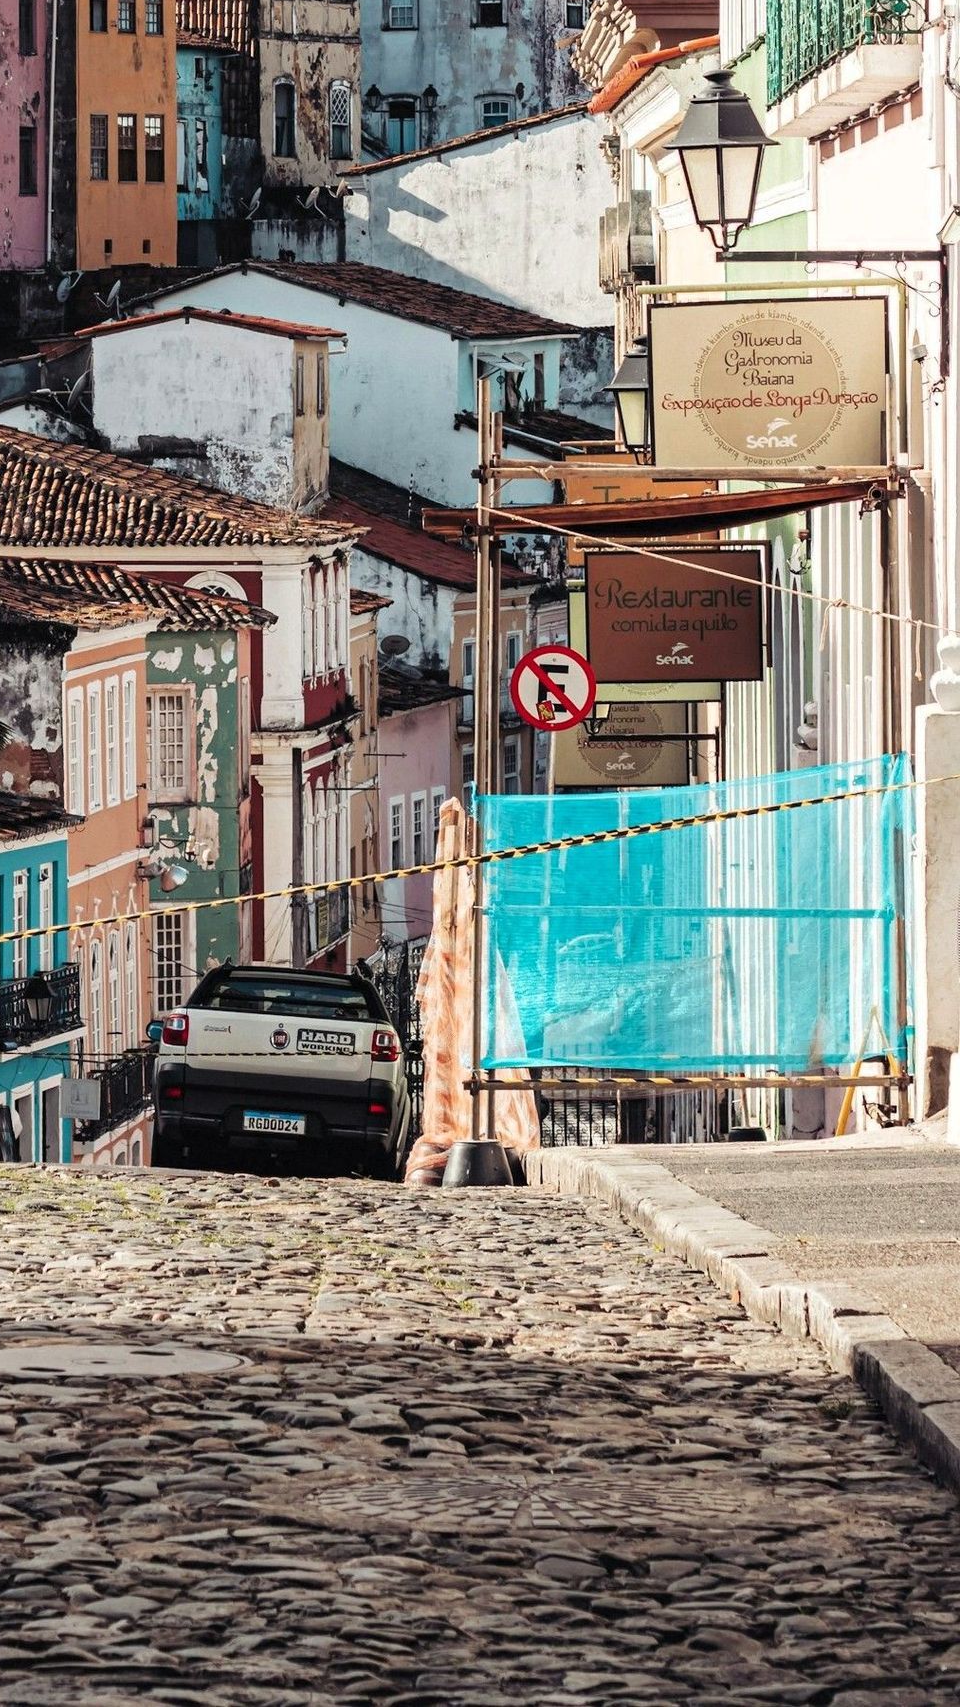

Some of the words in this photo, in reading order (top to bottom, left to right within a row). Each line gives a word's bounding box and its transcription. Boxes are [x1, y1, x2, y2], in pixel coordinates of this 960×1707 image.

[707, 323, 734, 345] kiambo
[736, 311, 765, 325] ndende
[768, 308, 797, 322] kiambo
[800, 320, 825, 340] ndende
[732, 330, 783, 347] Museu
[785, 328, 802, 346] da
[724, 348, 813, 375] Gastronomia
[742, 368, 794, 387] Baiana
[661, 393, 740, 417] Exposição
[741, 389, 762, 408] de
[764, 389, 812, 418] Longa
[812, 387, 879, 410] Duração
[594, 577, 753, 610] Restaurante
[611, 612, 677, 632] comida
[678, 619, 689, 632] a
[692, 612, 738, 642] quilo
[301, 1031, 352, 1044] HARD
[301, 1042, 351, 1053] WORKING
